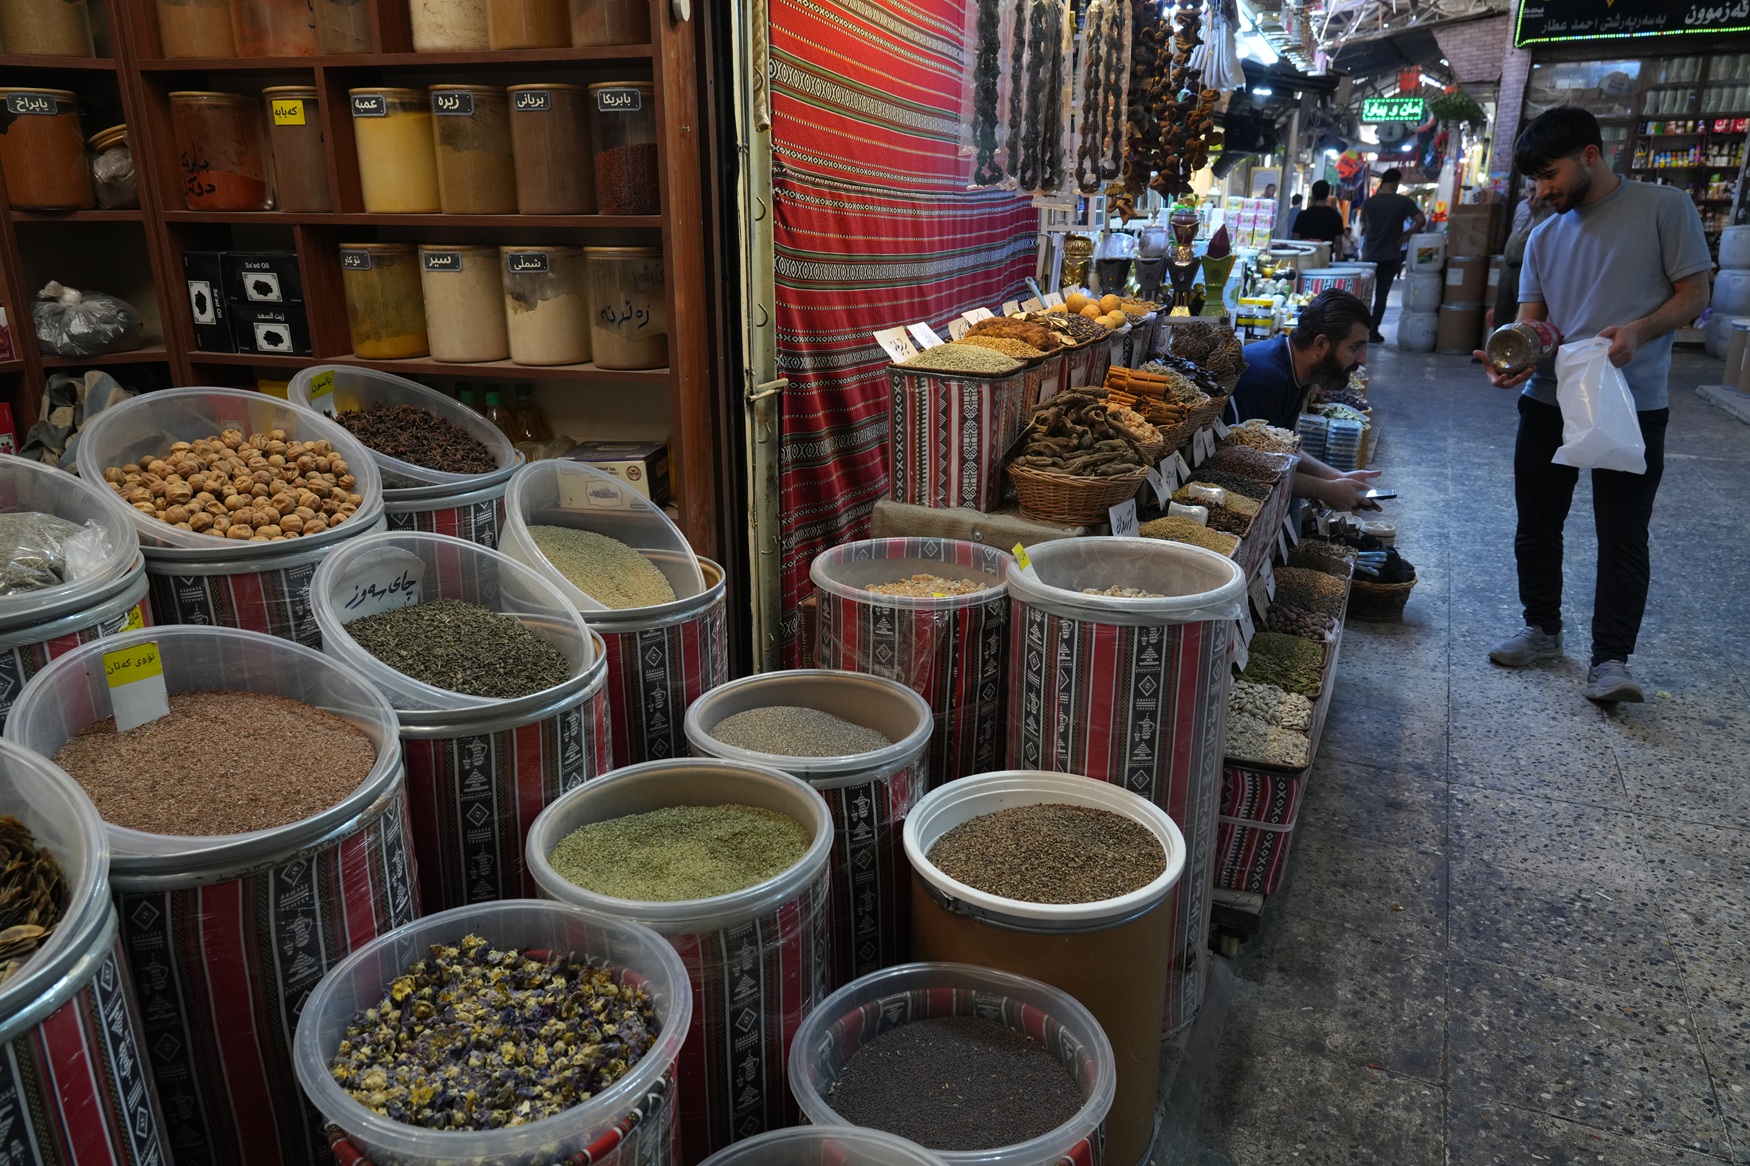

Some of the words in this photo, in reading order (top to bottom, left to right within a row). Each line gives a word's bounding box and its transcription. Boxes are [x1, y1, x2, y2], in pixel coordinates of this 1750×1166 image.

[1541, 18, 1568, 34] عطار
[1570, 17, 1598, 30] احمد
[428, 255, 452, 267] سیر
[388, 569, 418, 603] چای
